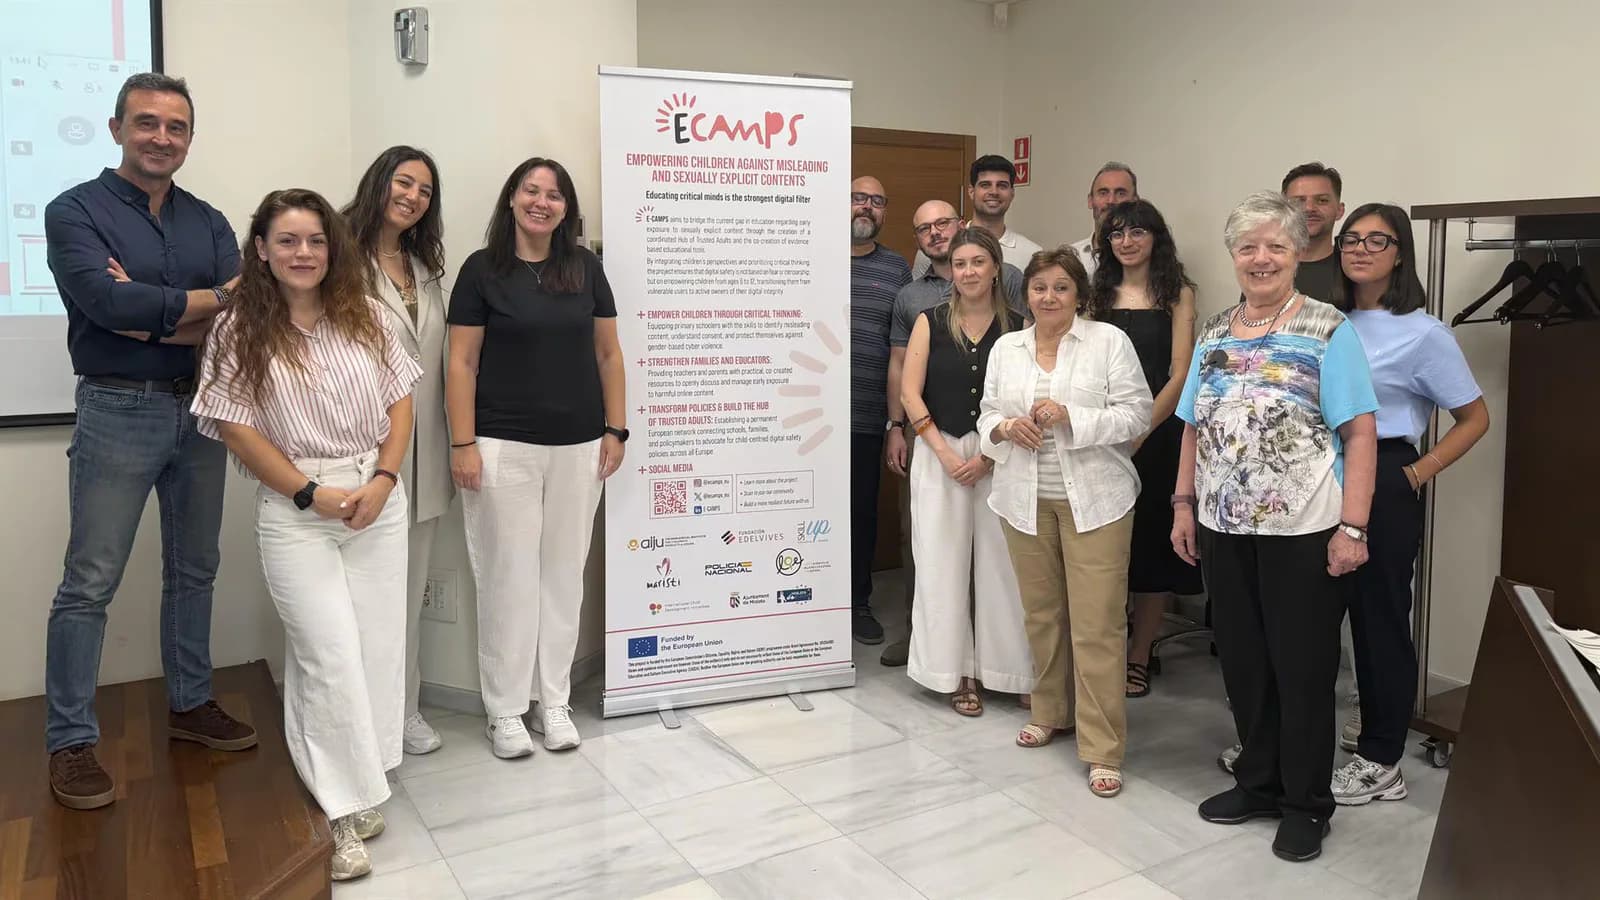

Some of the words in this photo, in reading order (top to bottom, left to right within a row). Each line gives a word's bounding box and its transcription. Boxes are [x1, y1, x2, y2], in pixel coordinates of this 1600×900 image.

[674, 111, 804, 149] ECAMPS
[627, 154, 688, 167] EMPOWERING
[691, 156, 734, 169] CHILDREN
[737, 158, 774, 170] AGAINST
[777, 160, 828, 173] MISLEADING
[652, 170, 670, 182] AND
[673, 171, 717, 184] SEXUALLY
[720, 172, 758, 185] EXPLICIT
[761, 174, 805, 186] CONTENTS
[646, 190, 679, 201] Educating
[680, 192, 703, 200] critical
[744, 194, 773, 203] strongest
[775, 195, 794, 204] digital
[796, 195, 810, 203] filter
[648, 311, 680, 319] EMPOWER
[682, 310, 712, 319] CHILDREN
[714, 310, 742, 318] THROUGH
[773, 310, 803, 318] THINKING:
[648, 357, 689, 366] STRENGTHEN
[691, 357, 720, 366] FAMILIES
[721, 356, 734, 365] AND
[735, 356, 773, 364] EDUCATORS:
[648, 405, 688, 414] TRANSFORM
[689, 403, 716, 412] POLICIES
[718, 403, 722, 411] &
[724, 402, 742, 411] BUILD
[743, 402, 755, 411] THE
[757, 402, 769, 410] HUB
[648, 418, 657, 426] OF
[658, 417, 687, 426] TRUSTED
[688, 416, 713, 425] ADULTS:
[648, 430, 673, 438] European
[648, 465, 671, 474] SOCIAL
[673, 464, 693, 472] MEDIA
[806, 520, 832, 543] up
[739, 534, 784, 543] EDELVIVES
[705, 568, 752, 576] NACIONAL
[647, 577, 680, 588] maristi
[673, 641, 703, 650] European
